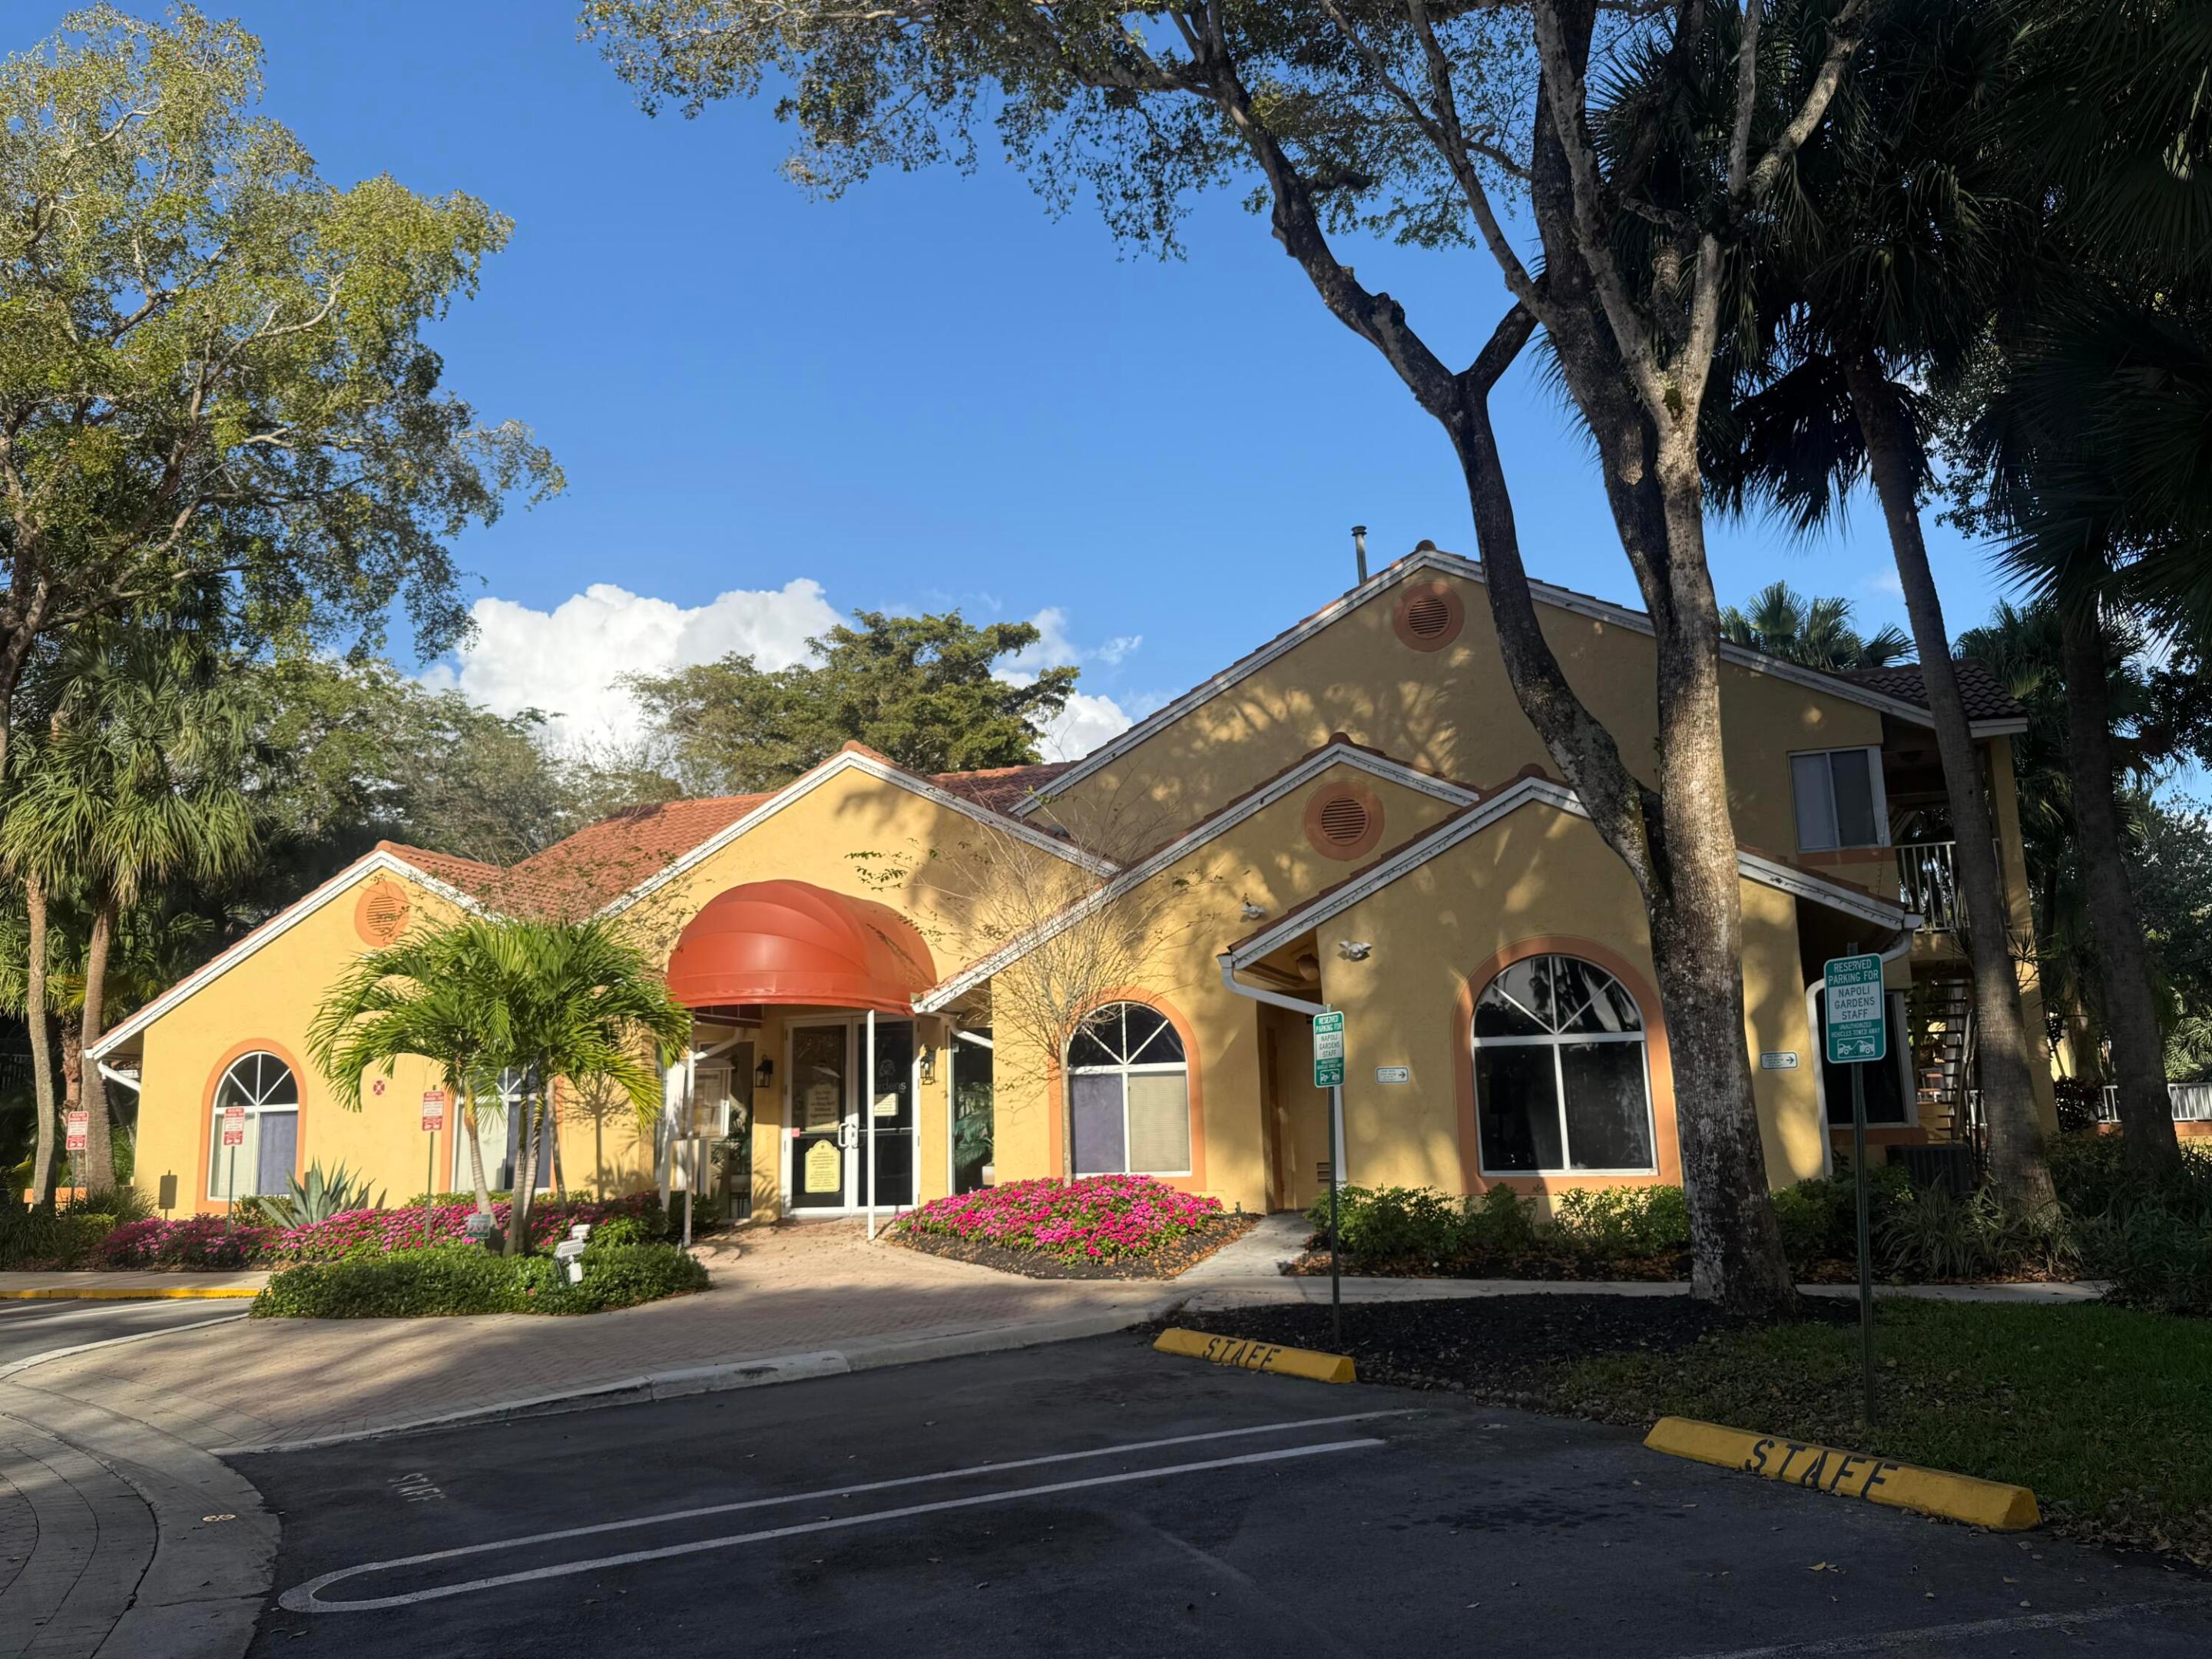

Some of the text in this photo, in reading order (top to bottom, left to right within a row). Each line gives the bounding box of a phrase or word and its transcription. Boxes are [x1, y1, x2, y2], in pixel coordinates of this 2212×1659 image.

[1833, 959, 1872, 973] RESERVED
[1829, 970, 1879, 985] PARKING FOR
[1838, 985, 1870, 998] NAPOLI
[1834, 997, 1875, 1009] GARDENS
[1842, 1008, 1868, 1021] STAFF
[1315, 1022, 1342, 1033] PARKING FOR
[1839, 1022, 1872, 1030] UNAUTHORIZED
[1831, 1029, 1852, 1038] VEHICLES
[1319, 1041, 1340, 1050] GARDENS
[1323, 1049, 1337, 1058] STAFF
[1202, 1336, 1281, 1369] STAFF
[1744, 1439, 1898, 1499] STAFF
[387, 1472, 446, 1502] STAFF
